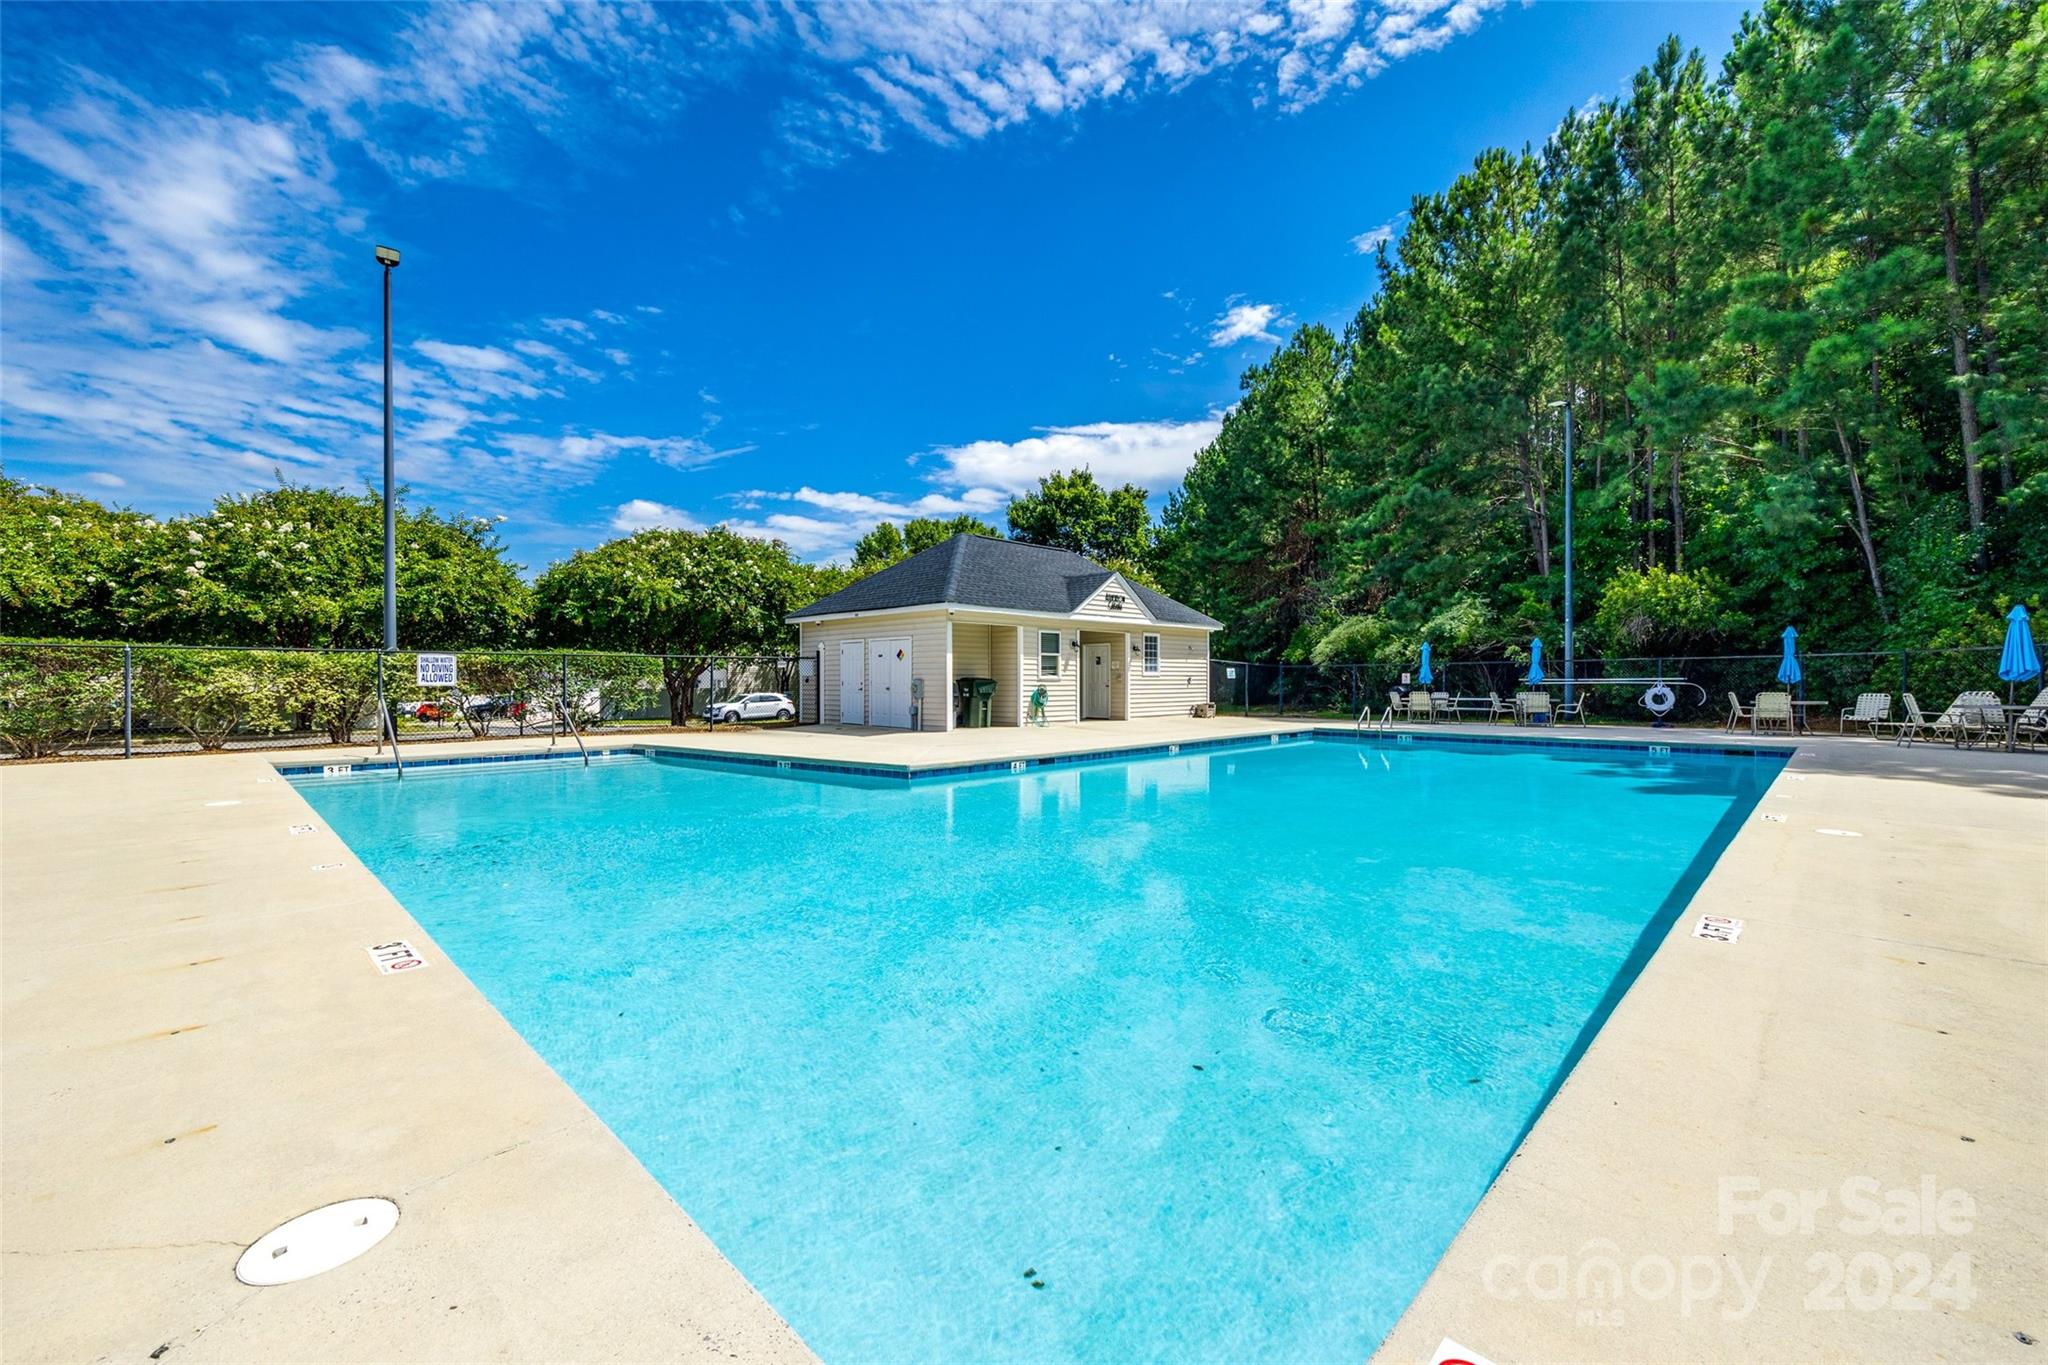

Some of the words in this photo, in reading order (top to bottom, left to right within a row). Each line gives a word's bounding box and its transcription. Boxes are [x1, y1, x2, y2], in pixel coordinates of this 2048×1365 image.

[420, 656, 439, 664] SHALLOW
[420, 664, 430, 673] NO
[431, 664, 454, 673] DIVING
[421, 673, 454, 683] ALLOWED
[377, 949, 414, 962] FT
